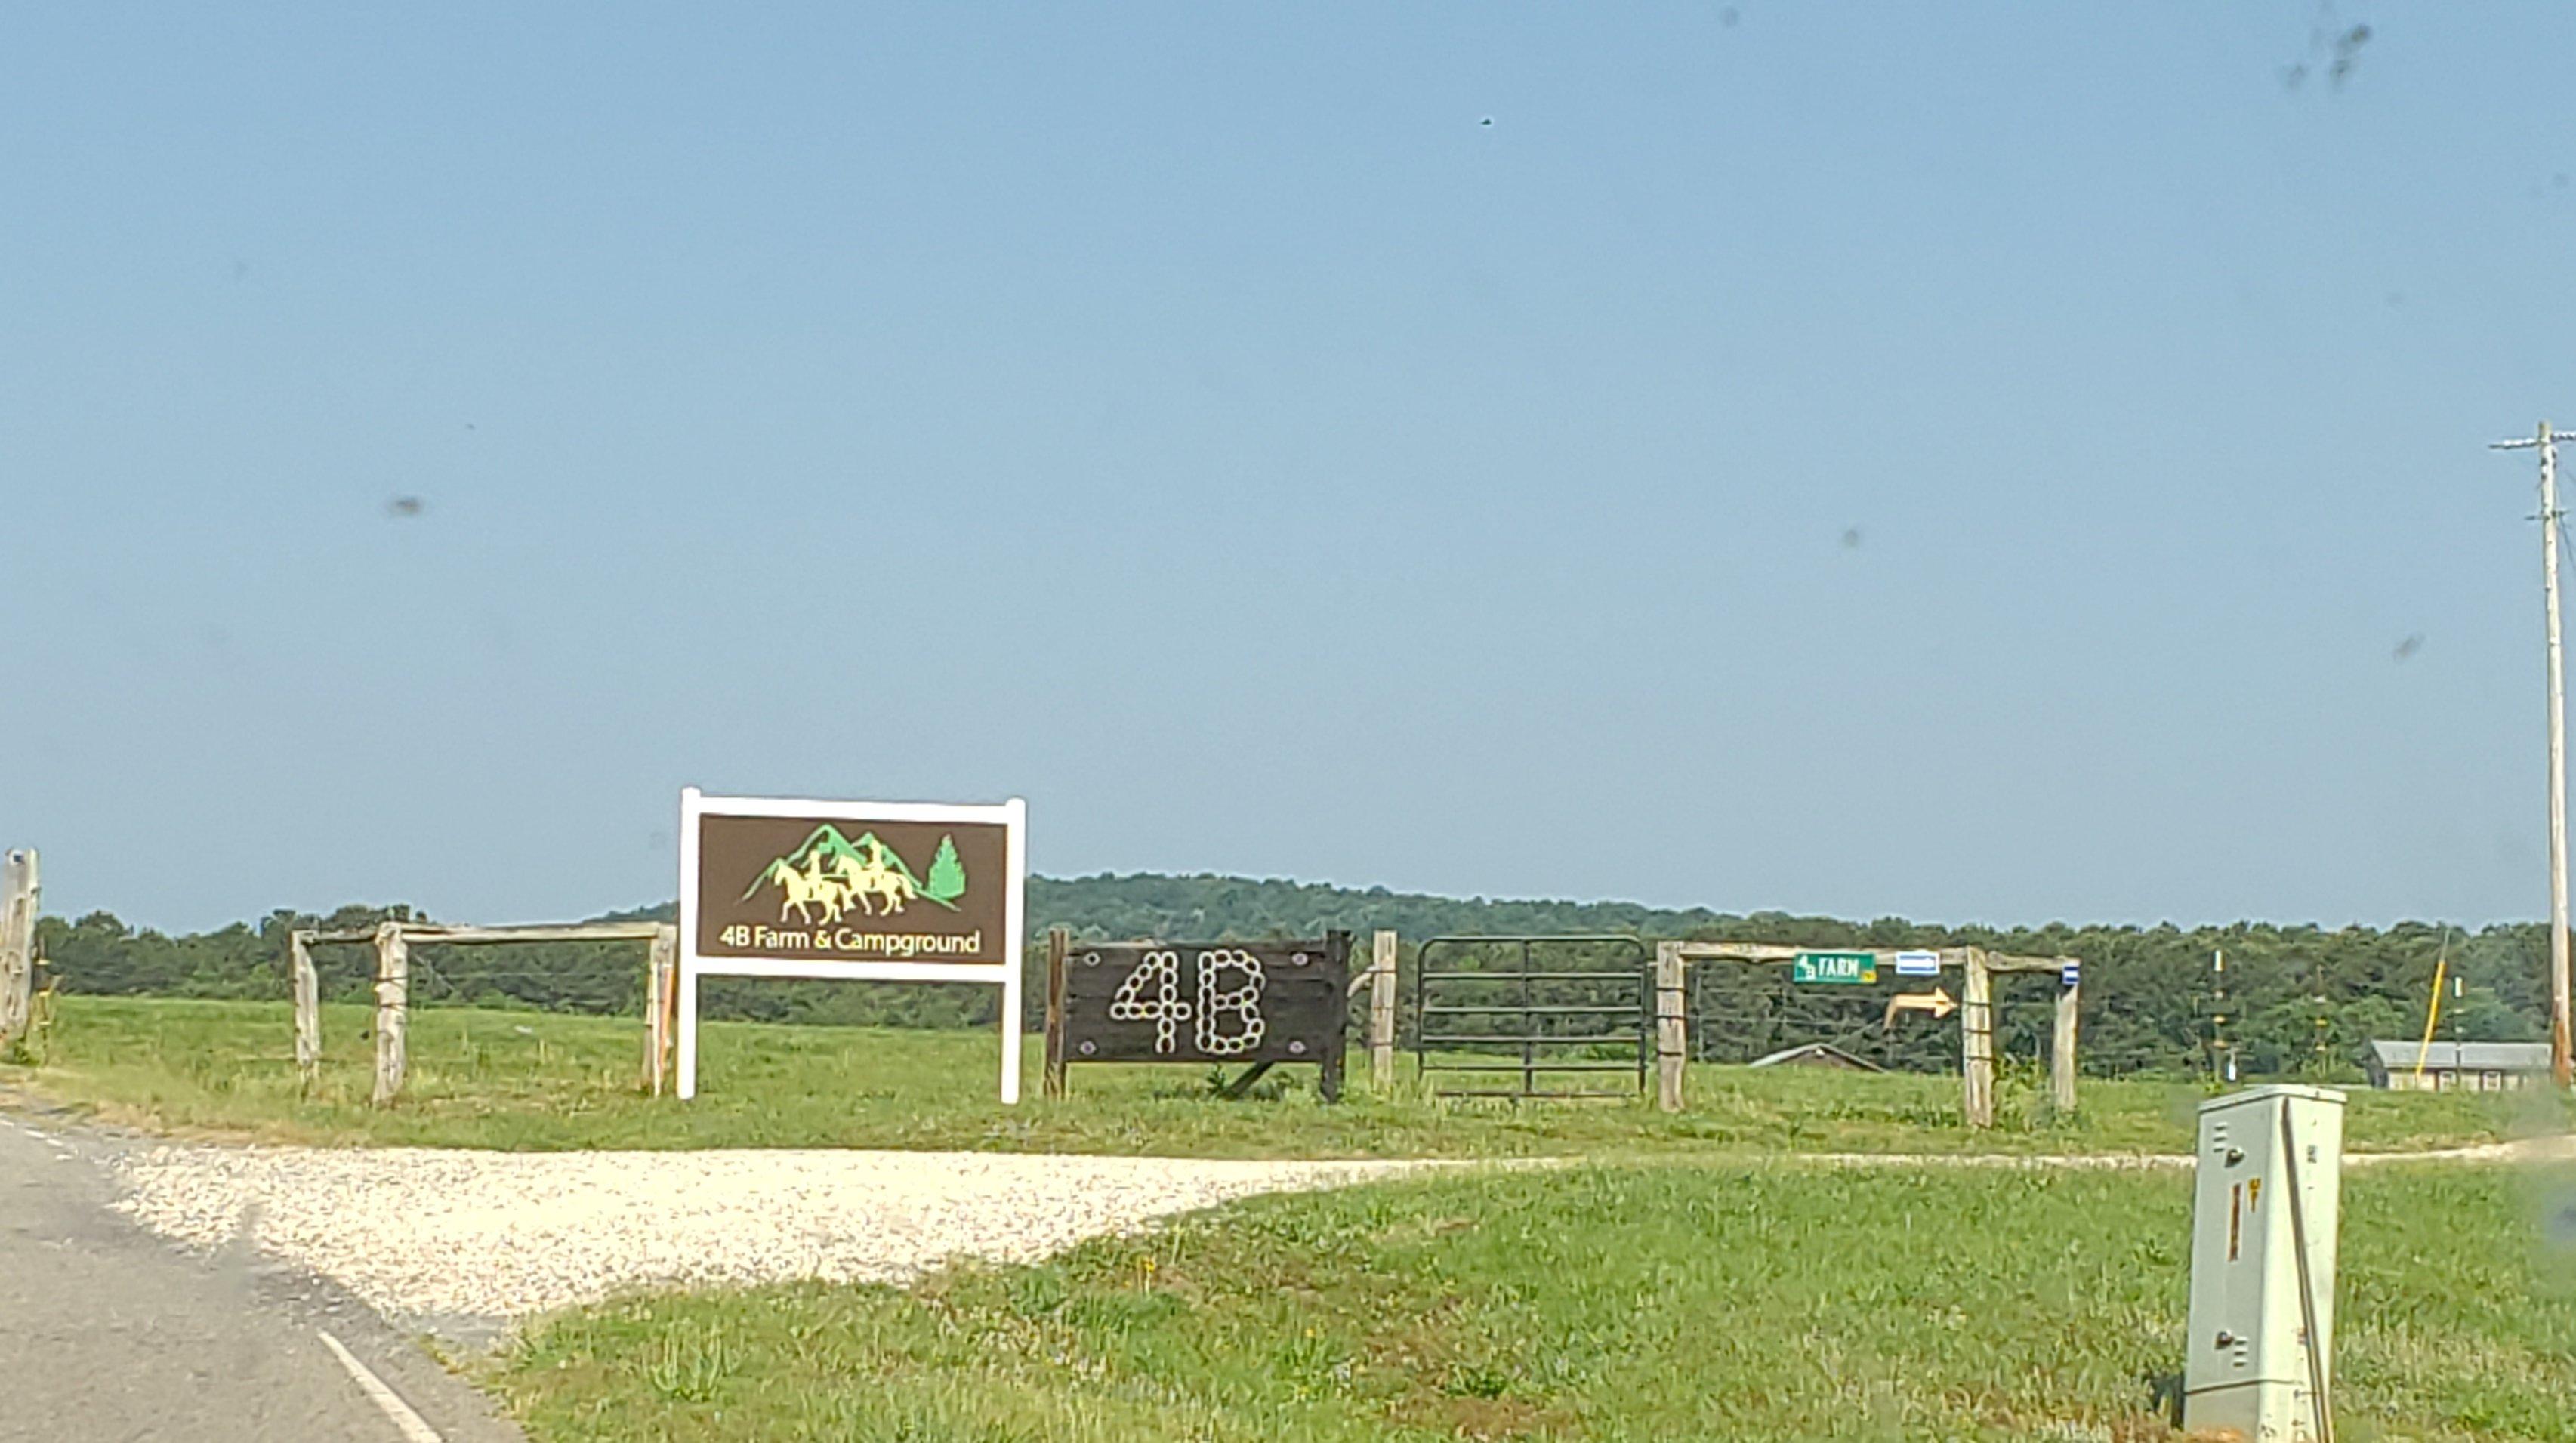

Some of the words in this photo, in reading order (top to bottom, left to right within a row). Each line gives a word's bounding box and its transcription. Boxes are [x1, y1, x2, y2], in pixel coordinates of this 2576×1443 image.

[720, 925, 751, 947] 4B
[754, 926, 810, 949] Farm
[814, 929, 831, 950] &
[835, 927, 981, 957] Campground
[1818, 957, 1859, 977] FARM
[1110, 949, 1266, 1055] 4B
